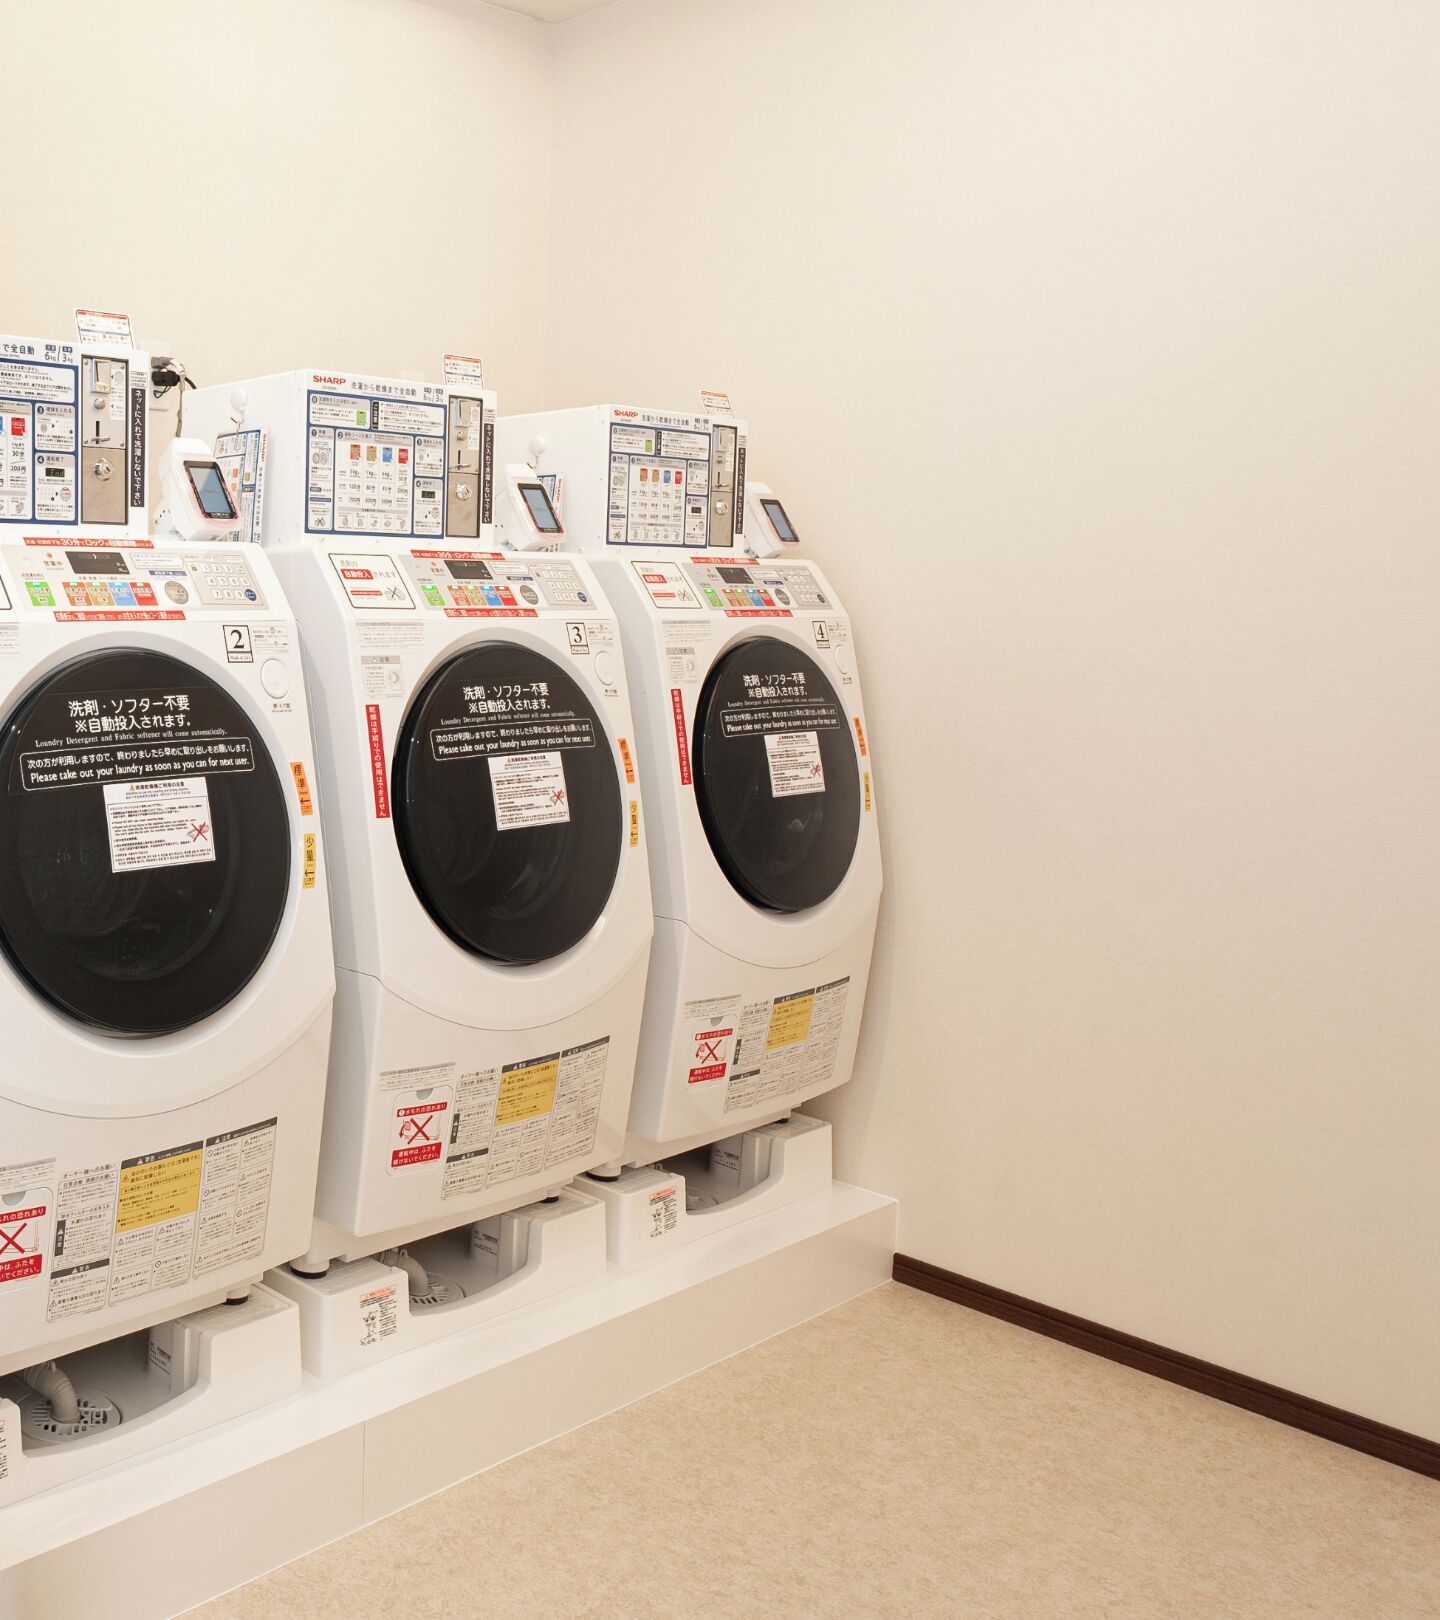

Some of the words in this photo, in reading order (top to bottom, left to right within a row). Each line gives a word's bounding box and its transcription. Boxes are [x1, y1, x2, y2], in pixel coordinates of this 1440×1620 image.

[313, 375, 346, 386] SHARP
[351, 381, 417, 397] 洗濯から乾燥まで全自動
[614, 409, 639, 418] SHARP
[134, 390, 143, 506] ネットに入れて洗濯しないで下さい
[230, 629, 245, 649] 2
[573, 626, 583, 644] 3
[817, 623, 825, 639] 4
[743, 672, 807, 687] 洗剤・ソフター不要
[462, 682, 550, 701] 洗剤・ソフター不要
[69, 694, 191, 718] 洗剤・ソフター不要
[468, 699, 551, 714] ※自動投入されます。
[75, 713, 192, 734] ※自動投入されます。
[35, 737, 64, 748] Loundry
[66, 734, 99, 745] Detergent
[101, 733, 113, 742] and
[115, 732, 135, 741] Fabric
[137, 730, 161, 739] softener
[162, 729, 174, 737] will
[191, 728, 228, 736] automatically.
[439, 745, 459, 755] Please
[460, 743, 473, 752] take
[474, 742, 485, 751] out
[486, 742, 499, 752] your
[499, 739, 520, 750] laundry
[546, 737, 555, 746] you
[672, 690, 689, 784] 乾燥は手絞りでの使用はできません
[27, 743, 250, 770] 次の方が利用しますので、終わりましたら早めに取り出しをお願いします。
[369, 706, 386, 817] 乾燥は手絞りでの使用はできません
[30, 772, 58, 784] Please
[59, 770, 78, 780] take
[79, 769, 94, 778] out
[97, 767, 113, 780] your
[115, 763, 143, 777] laundry
[145, 764, 153, 772] as
[154, 762, 172, 771] soon
[173, 761, 181, 770] as
[182, 760, 195, 772] you
[195, 759, 208, 768] can
[208, 757, 219, 767] for
[219, 757, 234, 766] next
[235, 757, 250, 766] user.
[306, 836, 314, 862] 少量
[62, 1162, 116, 1180] オーナー様へのお願い
